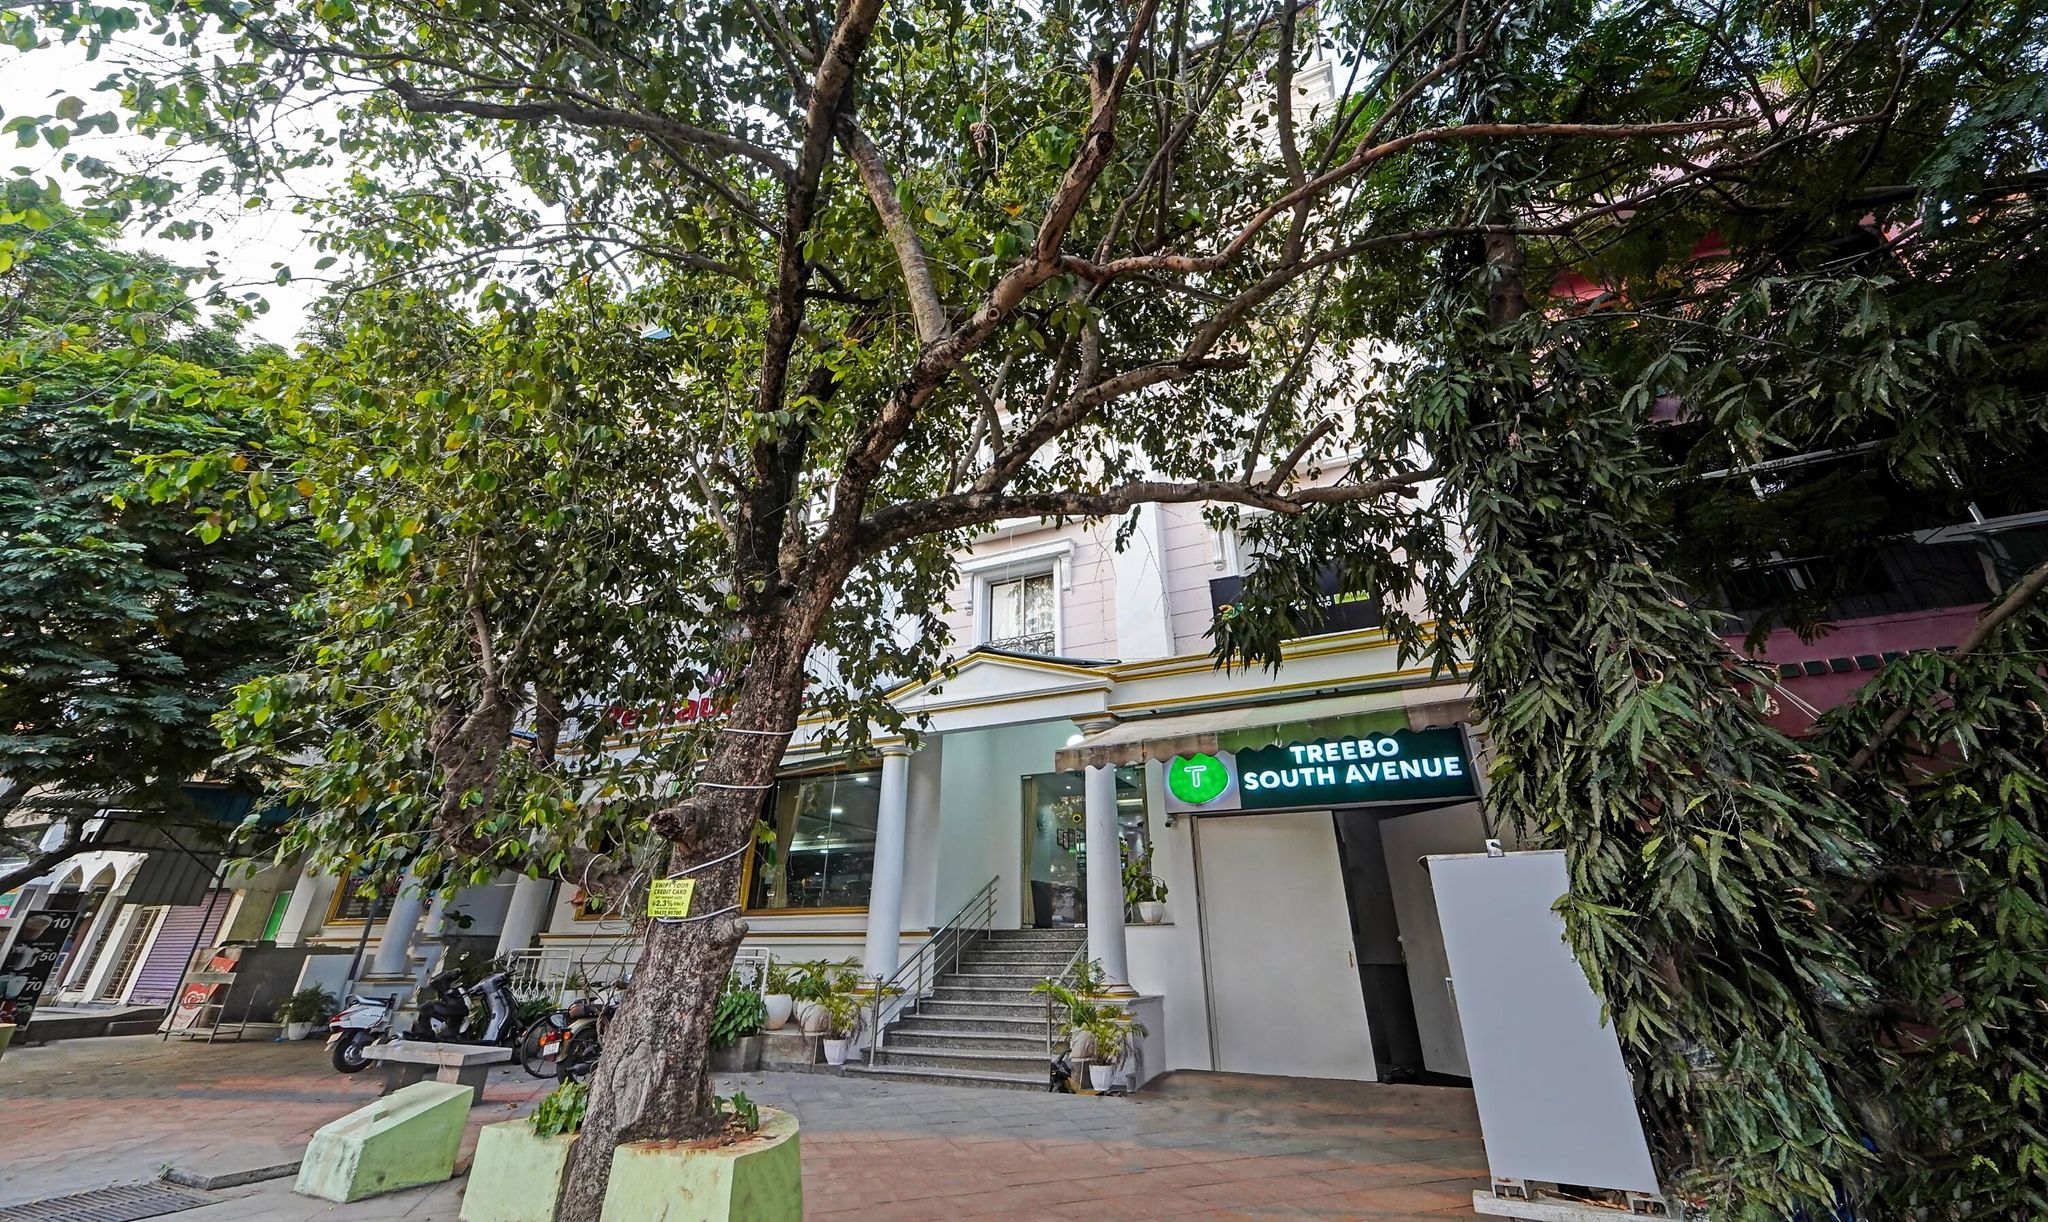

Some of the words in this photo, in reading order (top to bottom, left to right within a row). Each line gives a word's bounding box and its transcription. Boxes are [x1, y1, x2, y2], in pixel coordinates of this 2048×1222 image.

[1290, 738, 1399, 765] TREEBO
[1184, 765, 1208, 788] T
[1244, 763, 1337, 790] SOUTH
[1345, 757, 1463, 784] AVENUE
[53, 918, 71, 929] 10
[39, 952, 57, 962] 50
[25, 982, 43, 991] 70
